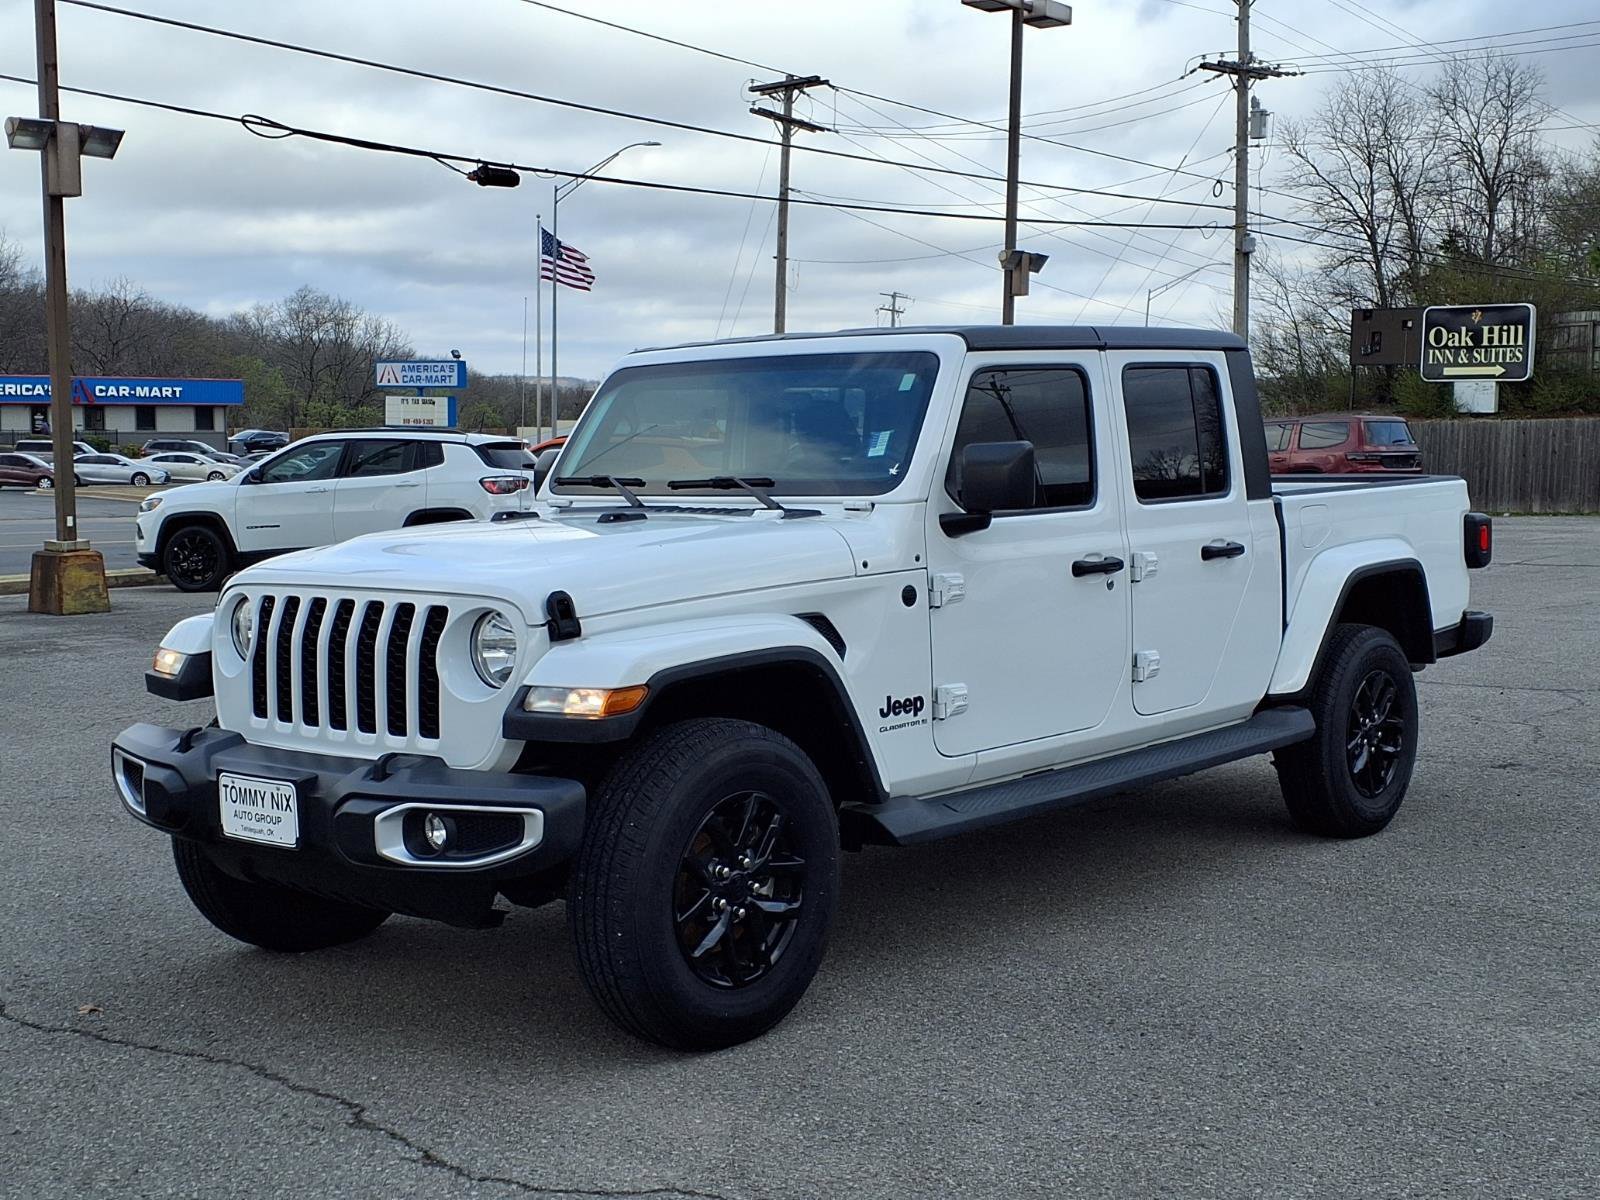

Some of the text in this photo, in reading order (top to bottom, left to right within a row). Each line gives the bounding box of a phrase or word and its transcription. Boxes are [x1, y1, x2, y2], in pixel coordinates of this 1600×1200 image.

[1428, 325, 1524, 348] Oak Hill
[1428, 347, 1524, 365] INN & SUITES
[400, 365, 455, 374] AMERICA'S
[402, 374, 453, 384] CAR-MART
[95, 385, 183, 398] CAR-MART
[879, 695, 925, 719] Jeep
[879, 719, 921, 733] GLADIATOR
[222, 783, 293, 813] TOMMY NIX
[233, 809, 283, 826] AUTO GROUP
